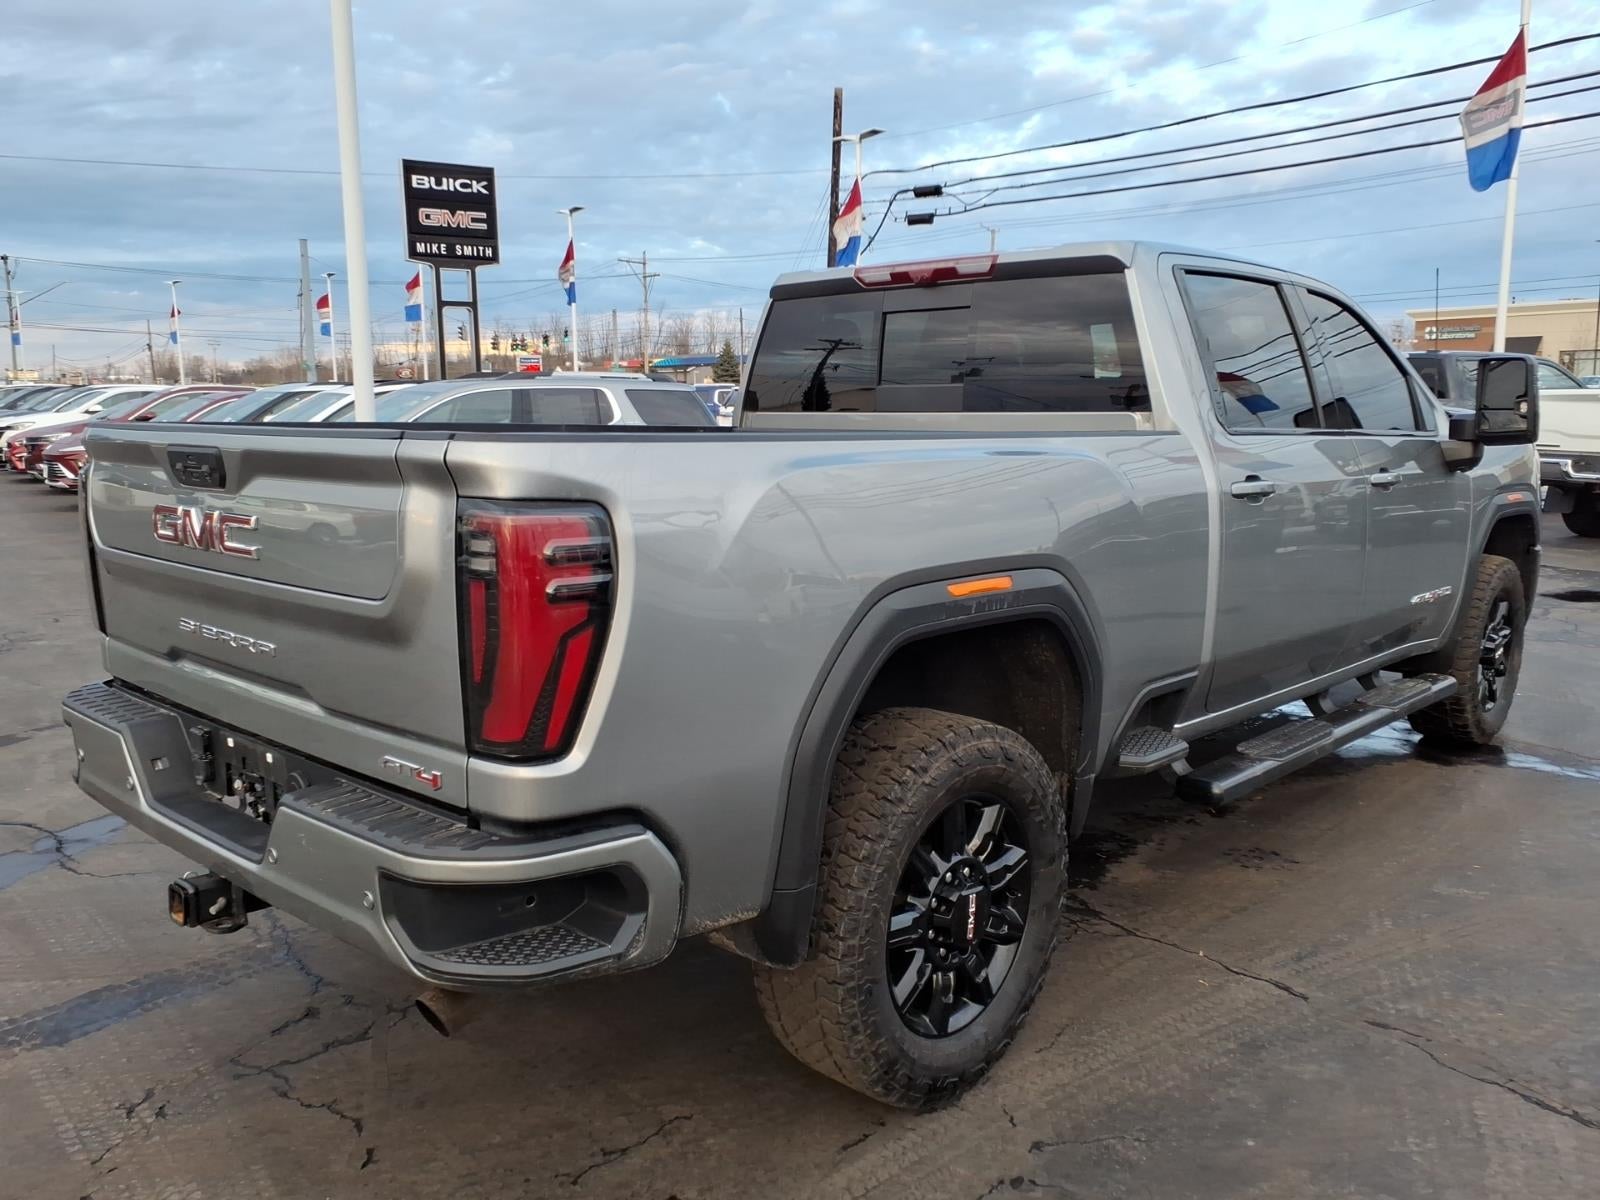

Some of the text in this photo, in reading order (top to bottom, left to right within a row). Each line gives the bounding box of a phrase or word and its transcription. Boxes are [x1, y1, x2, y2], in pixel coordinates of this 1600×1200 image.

[411, 174, 489, 195] BUICK
[418, 207, 488, 230] GMC
[416, 242, 493, 257] MIKE SMITH
[152, 504, 262, 560] GMC
[178, 617, 277, 658] SIERRA
[382, 755, 442, 791] AT4
[966, 893, 977, 942] GMC
